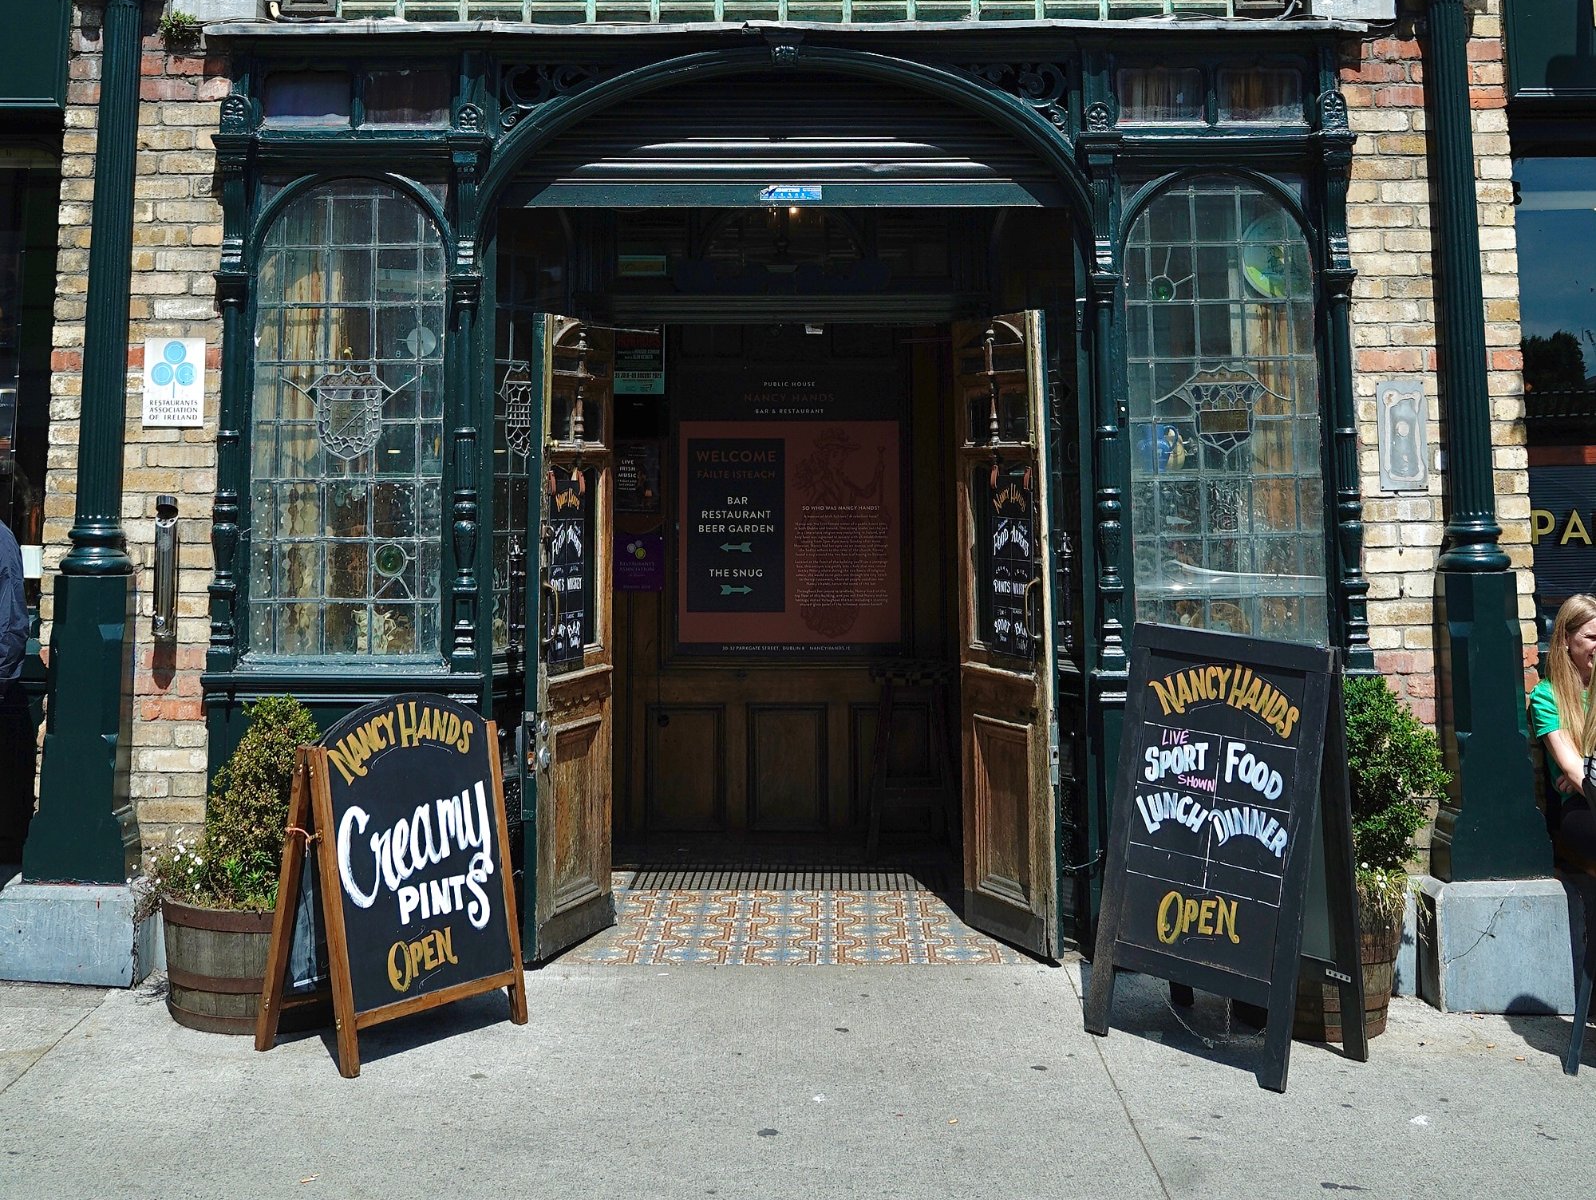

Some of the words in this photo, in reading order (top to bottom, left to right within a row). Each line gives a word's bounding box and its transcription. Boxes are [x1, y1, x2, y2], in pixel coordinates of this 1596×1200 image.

[744, 393, 786, 402] NANCY
[792, 393, 835, 402] HANDS
[696, 451, 776, 463] WELCOME
[732, 470, 775, 479] ISTEACH
[701, 510, 772, 519] RESTAURANT
[727, 496, 748, 505] BAR
[698, 524, 725, 533] BEER
[728, 524, 774, 533] GARDEN
[709, 568, 730, 577] THE
[732, 568, 763, 577] SNUG
[1148, 665, 1232, 716] NANCY
[1226, 663, 1300, 739] HANDS
[326, 711, 396, 786] NANCY
[396, 701, 474, 754] HANDS
[1161, 728, 1190, 746] LIVE
[1144, 742, 1209, 782] SPORT
[1224, 741, 1284, 801] FOOD
[1177, 773, 1217, 793] SHOWN
[1135, 791, 1210, 835] LUNCH
[1207, 806, 1289, 858] DINNER
[337, 780, 494, 908] Creamy
[397, 866, 490, 930] PINTS
[1157, 890, 1240, 945] OPEN
[387, 926, 459, 992] OPEN
